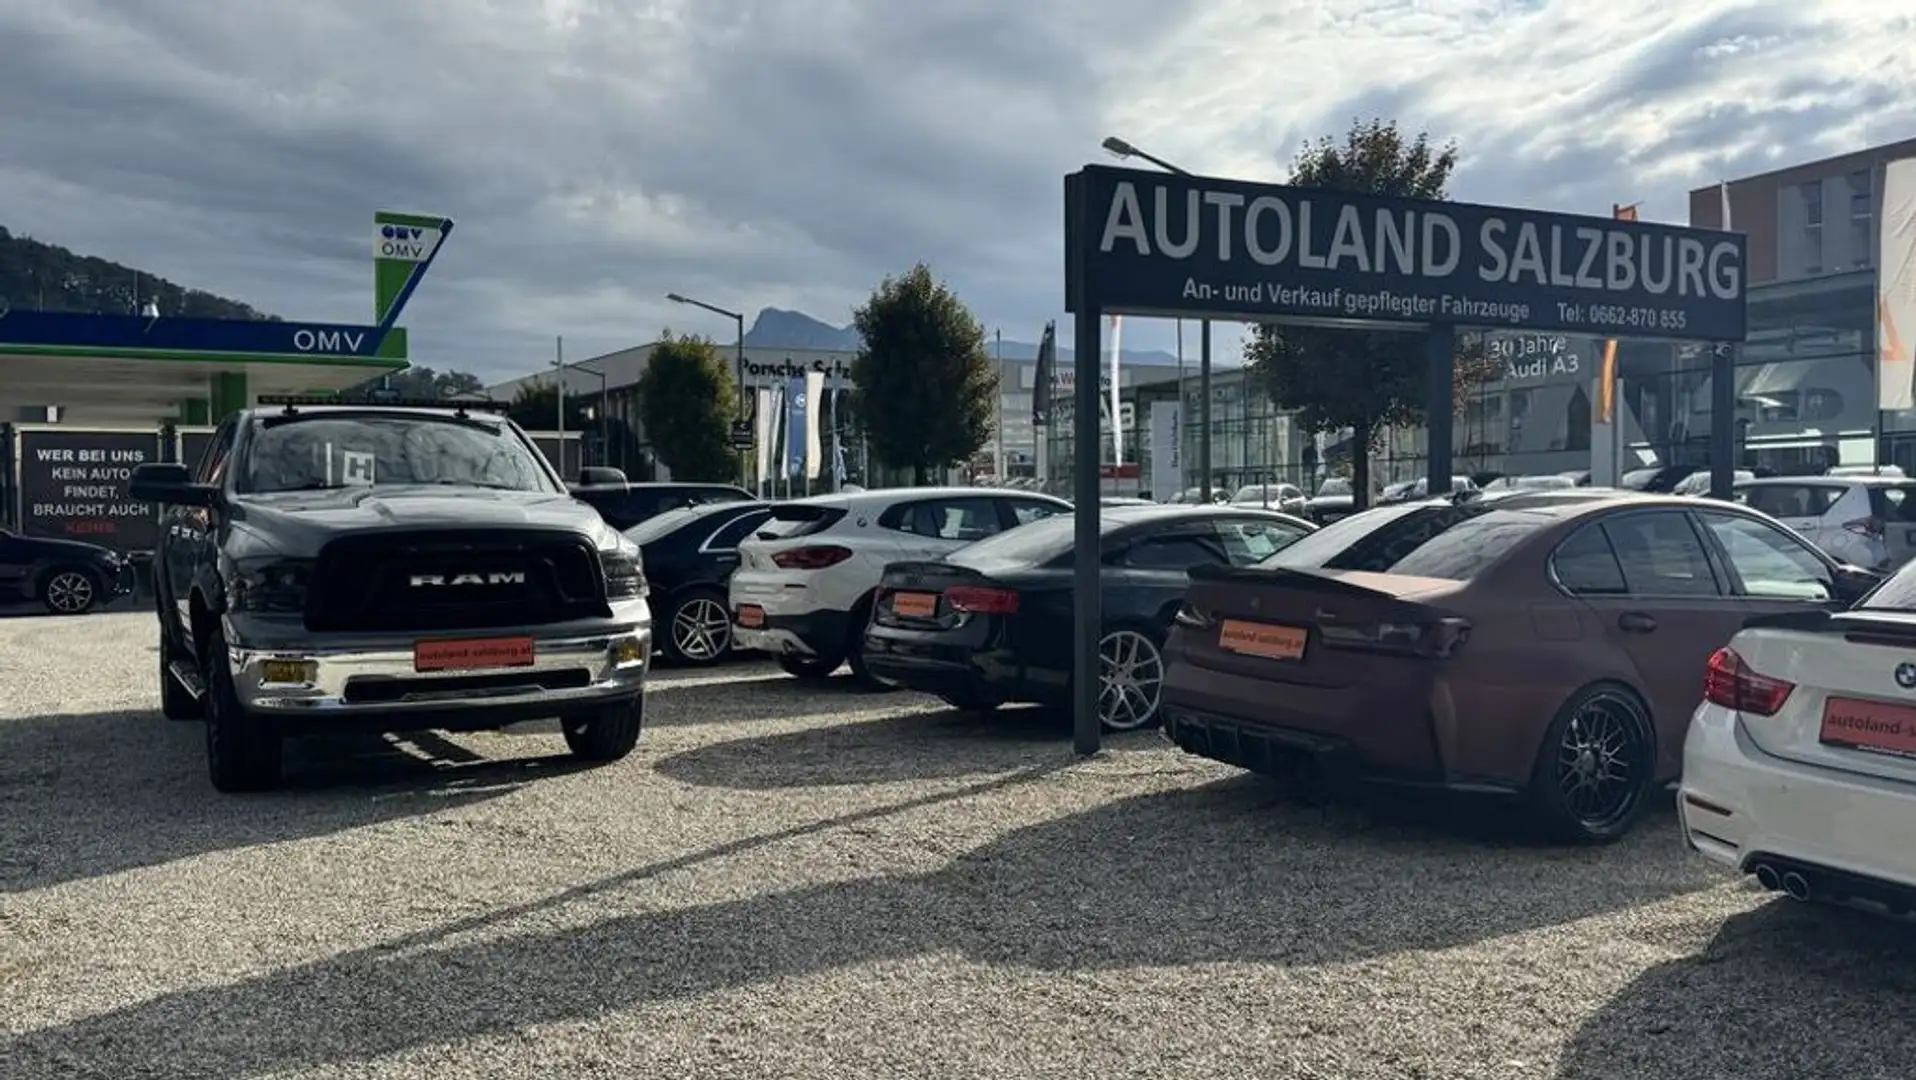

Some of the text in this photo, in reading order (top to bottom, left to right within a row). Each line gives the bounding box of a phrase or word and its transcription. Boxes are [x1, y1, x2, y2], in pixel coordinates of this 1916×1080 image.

[1100, 182, 1740, 300] AUTOLAND SALZBURG
[382, 243, 423, 258] OMV
[1183, 277, 1687, 330] An- und Verkauf gepflegter Fahrzeuge Tel: 0662-870 855
[293, 329, 365, 352] OMV
[1552, 353, 1580, 376] A3
[36, 448, 144, 462] WER BEI UNS
[51, 466, 131, 480] KEIN AUTO
[63, 484, 119, 500] FINDET,
[33, 503, 150, 517] BRAUCHT AUCH
[409, 572, 526, 587] RAM
